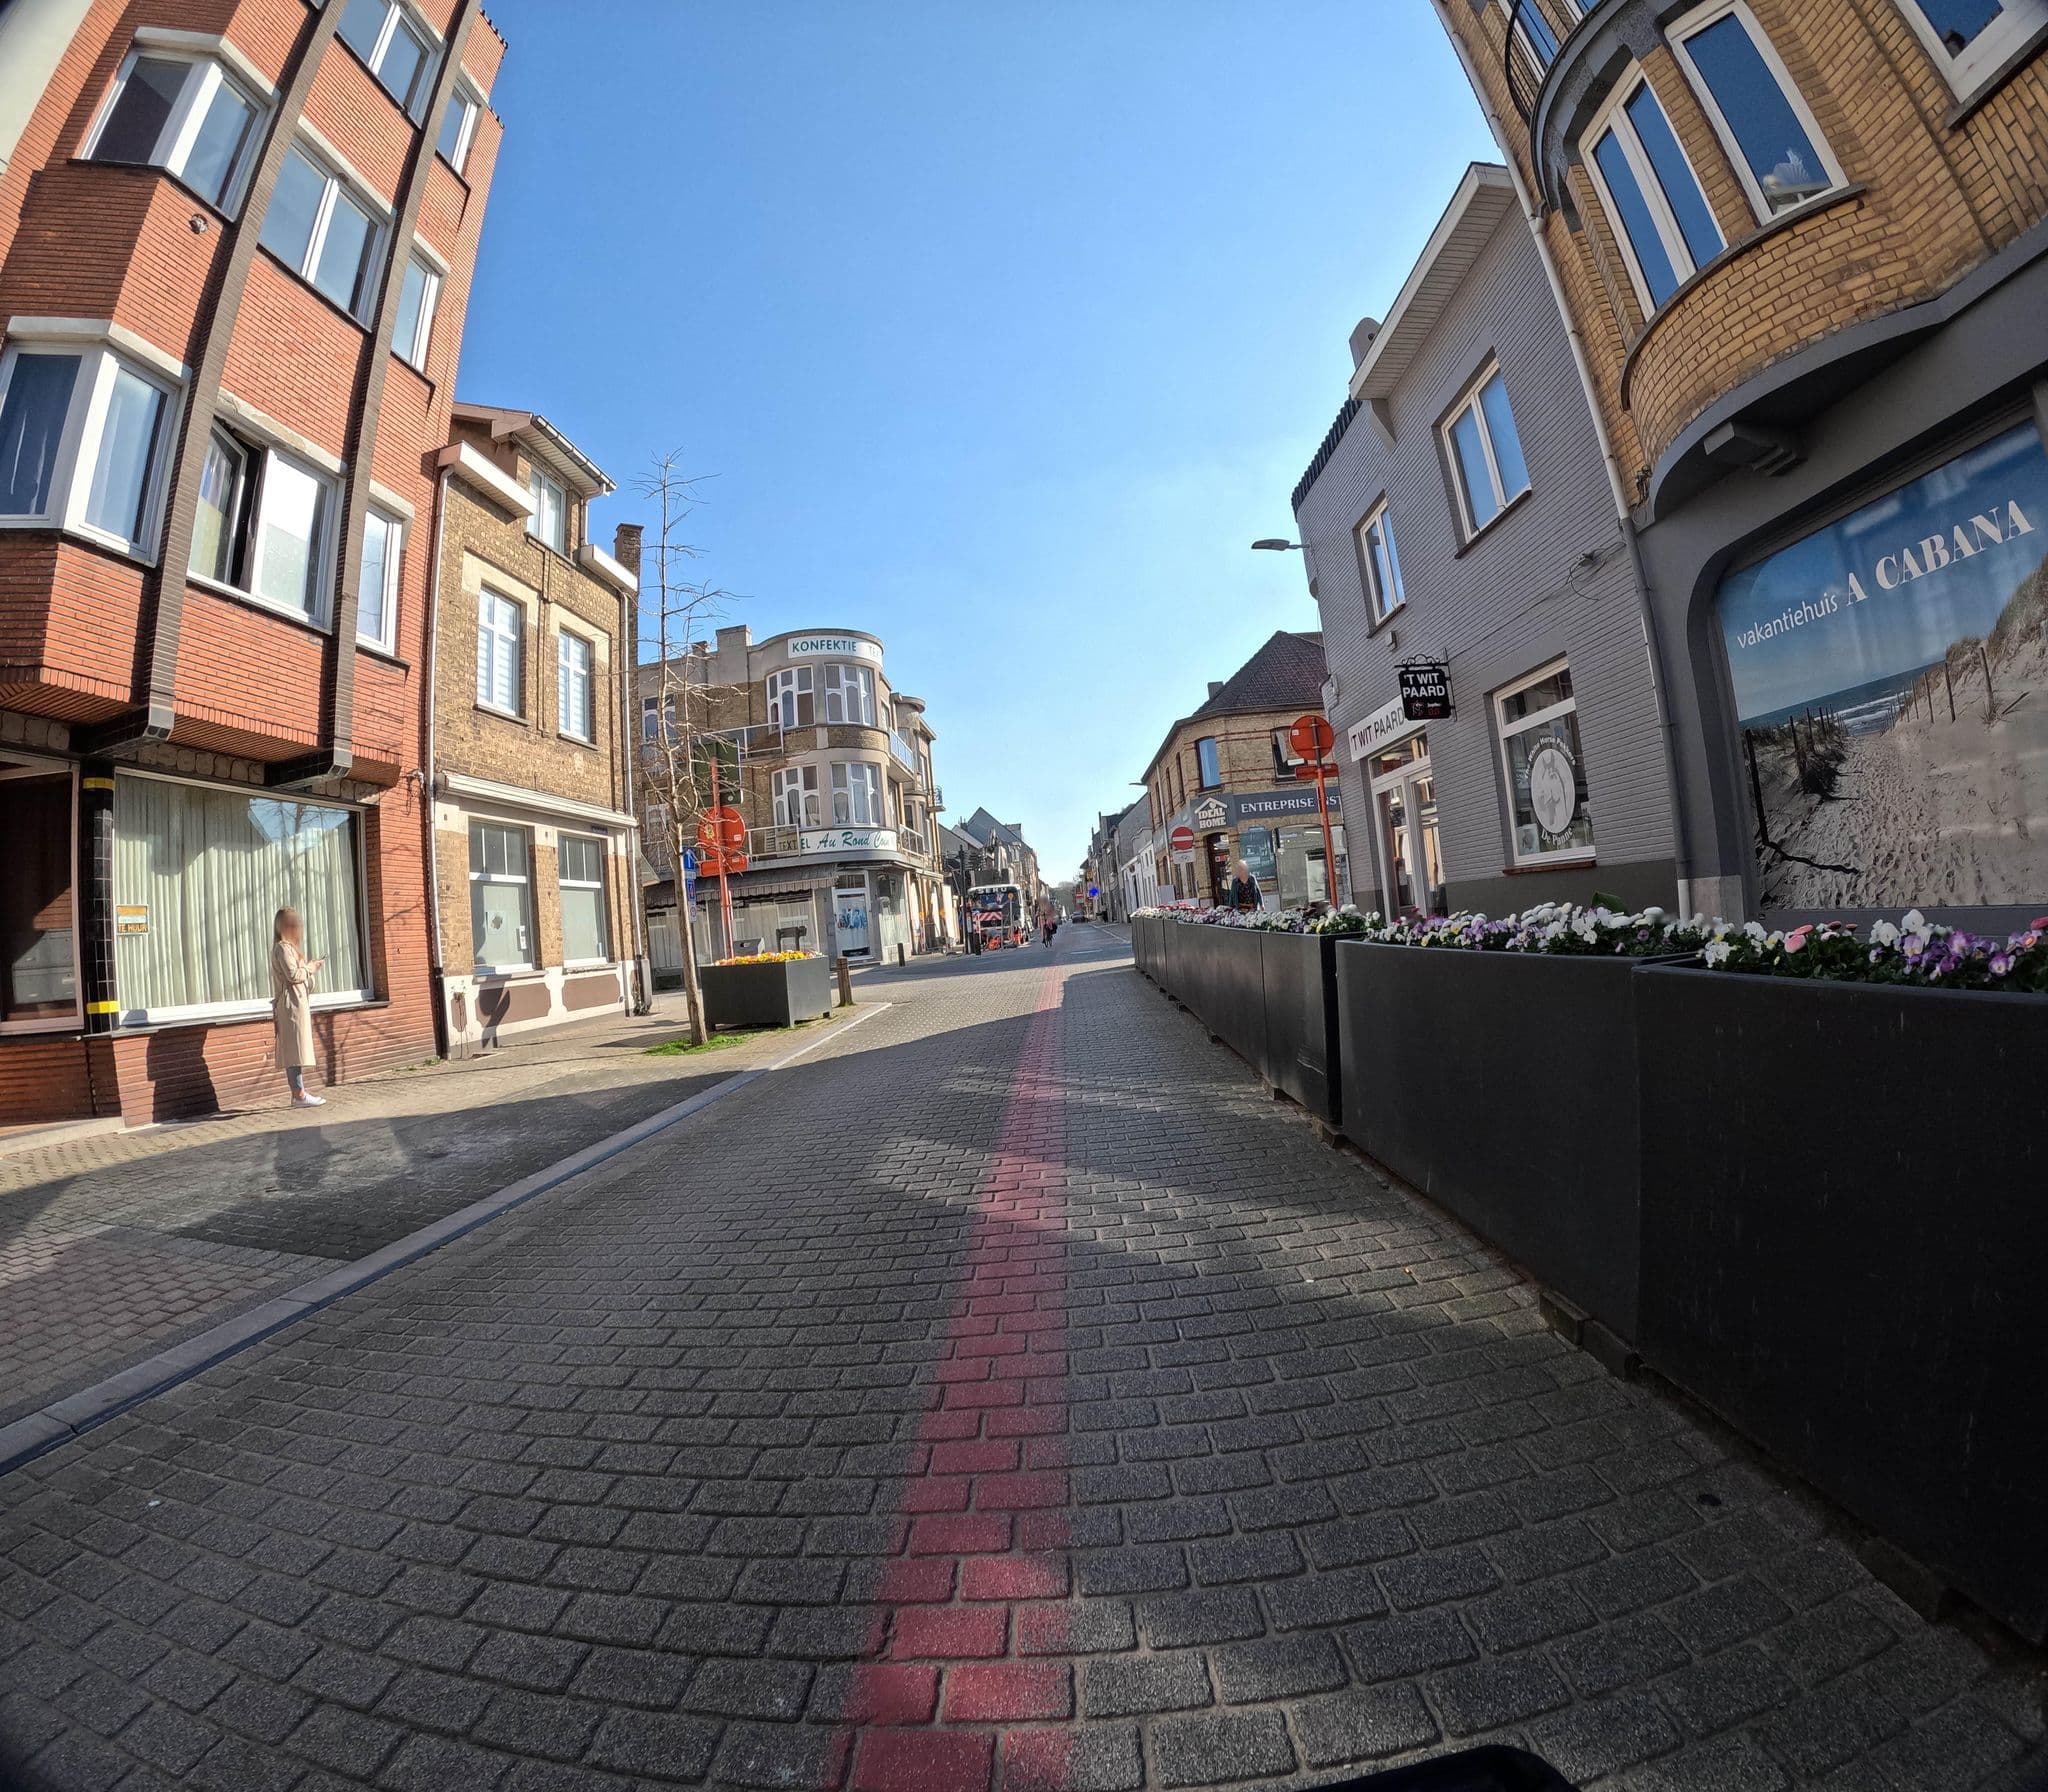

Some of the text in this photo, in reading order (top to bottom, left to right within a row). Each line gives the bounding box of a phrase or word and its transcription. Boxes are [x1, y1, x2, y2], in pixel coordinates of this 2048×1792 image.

[1737, 499, 2036, 649] vakantiehuis A CABANA
[792, 639, 857, 653] KONFEKTIE
[1416, 672, 1439, 685] WIT
[1402, 685, 1446, 698] PAARD
[1357, 724, 1372, 748] WIT
[1374, 707, 1405, 739] PAARD
[1241, 797, 1315, 813] ENTREPRISE
[1198, 807, 1226, 820] IDEAL
[1199, 816, 1227, 829] HOME
[778, 838, 811, 852] TEXTEL
[817, 832, 836, 849] Au
[842, 831, 870, 847] Rond
